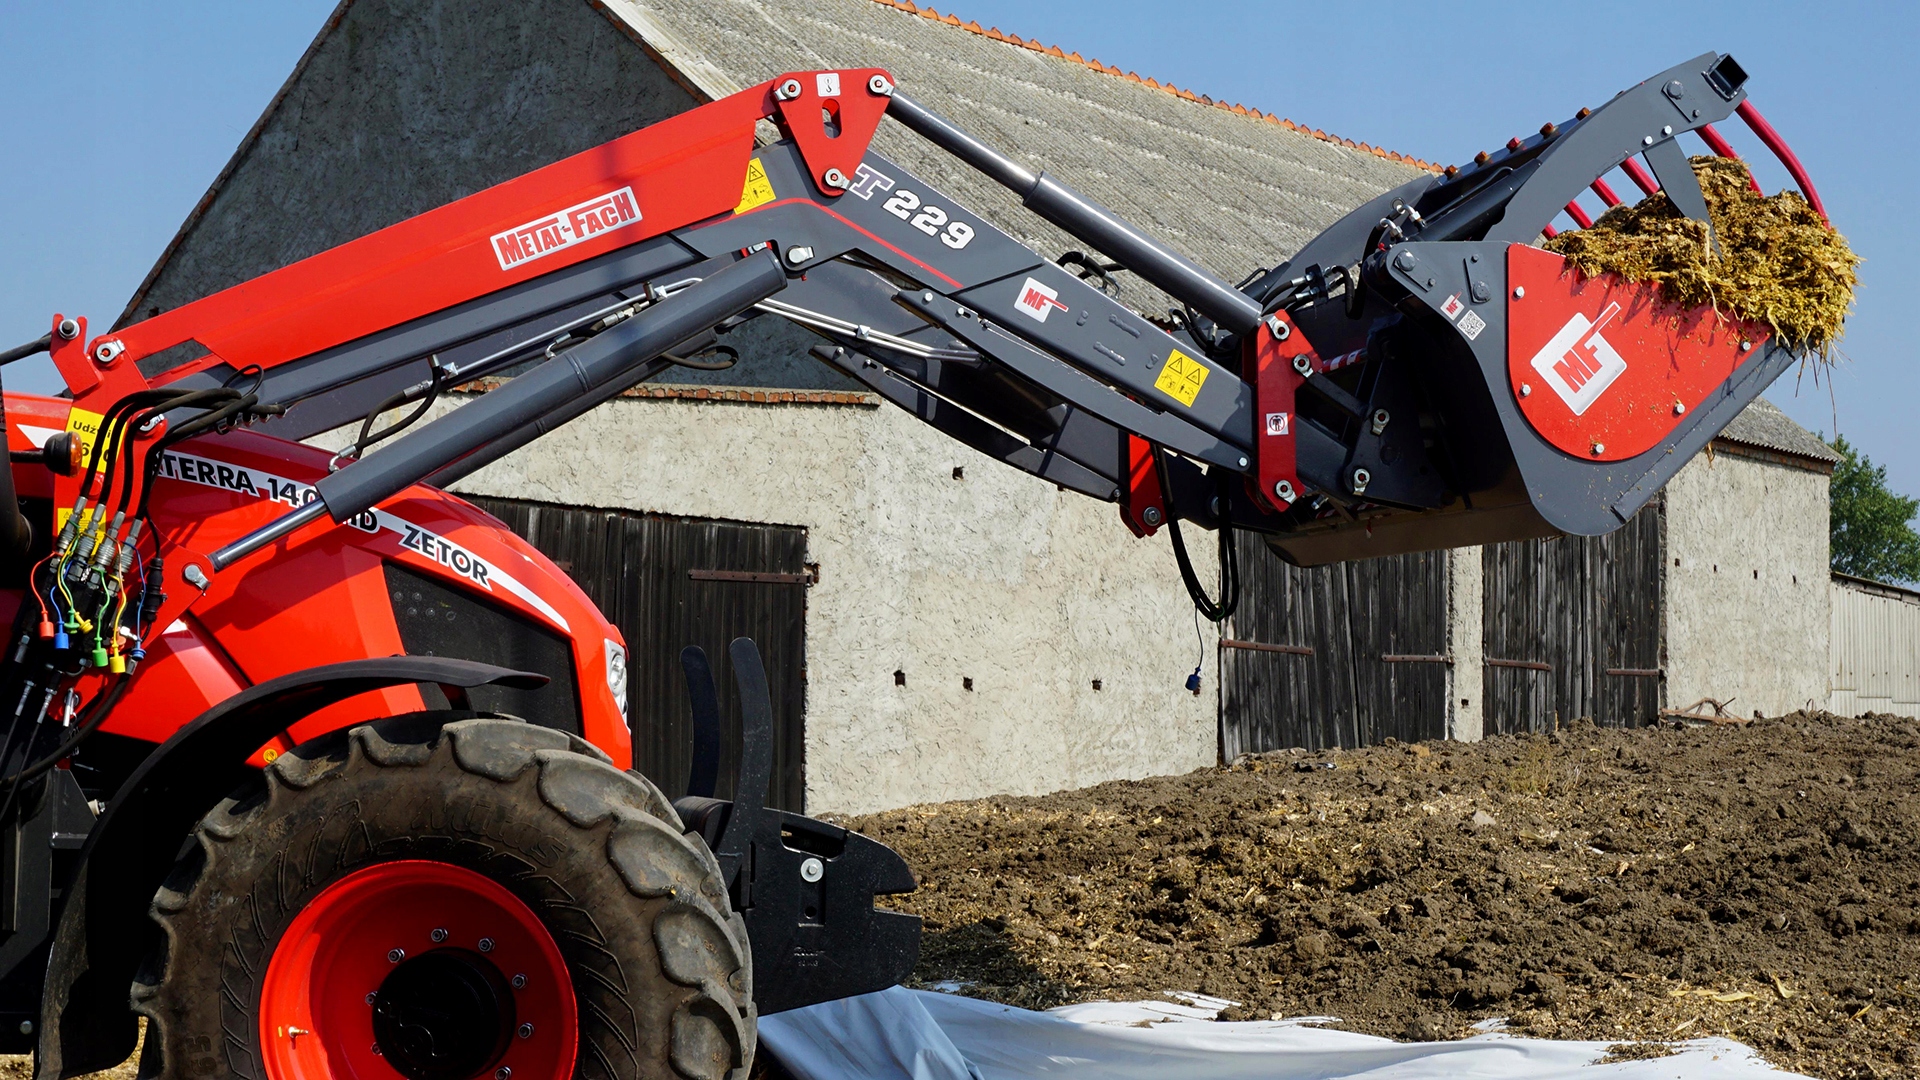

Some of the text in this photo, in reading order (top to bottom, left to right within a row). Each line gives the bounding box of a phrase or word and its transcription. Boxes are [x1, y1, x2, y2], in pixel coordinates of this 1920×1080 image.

[849, 162, 976, 250] T 229
[1022, 287, 1068, 312] MF
[1552, 303, 1619, 394] MF
[158, 454, 258, 495] TERRA
[402, 524, 489, 587] ZETOR
